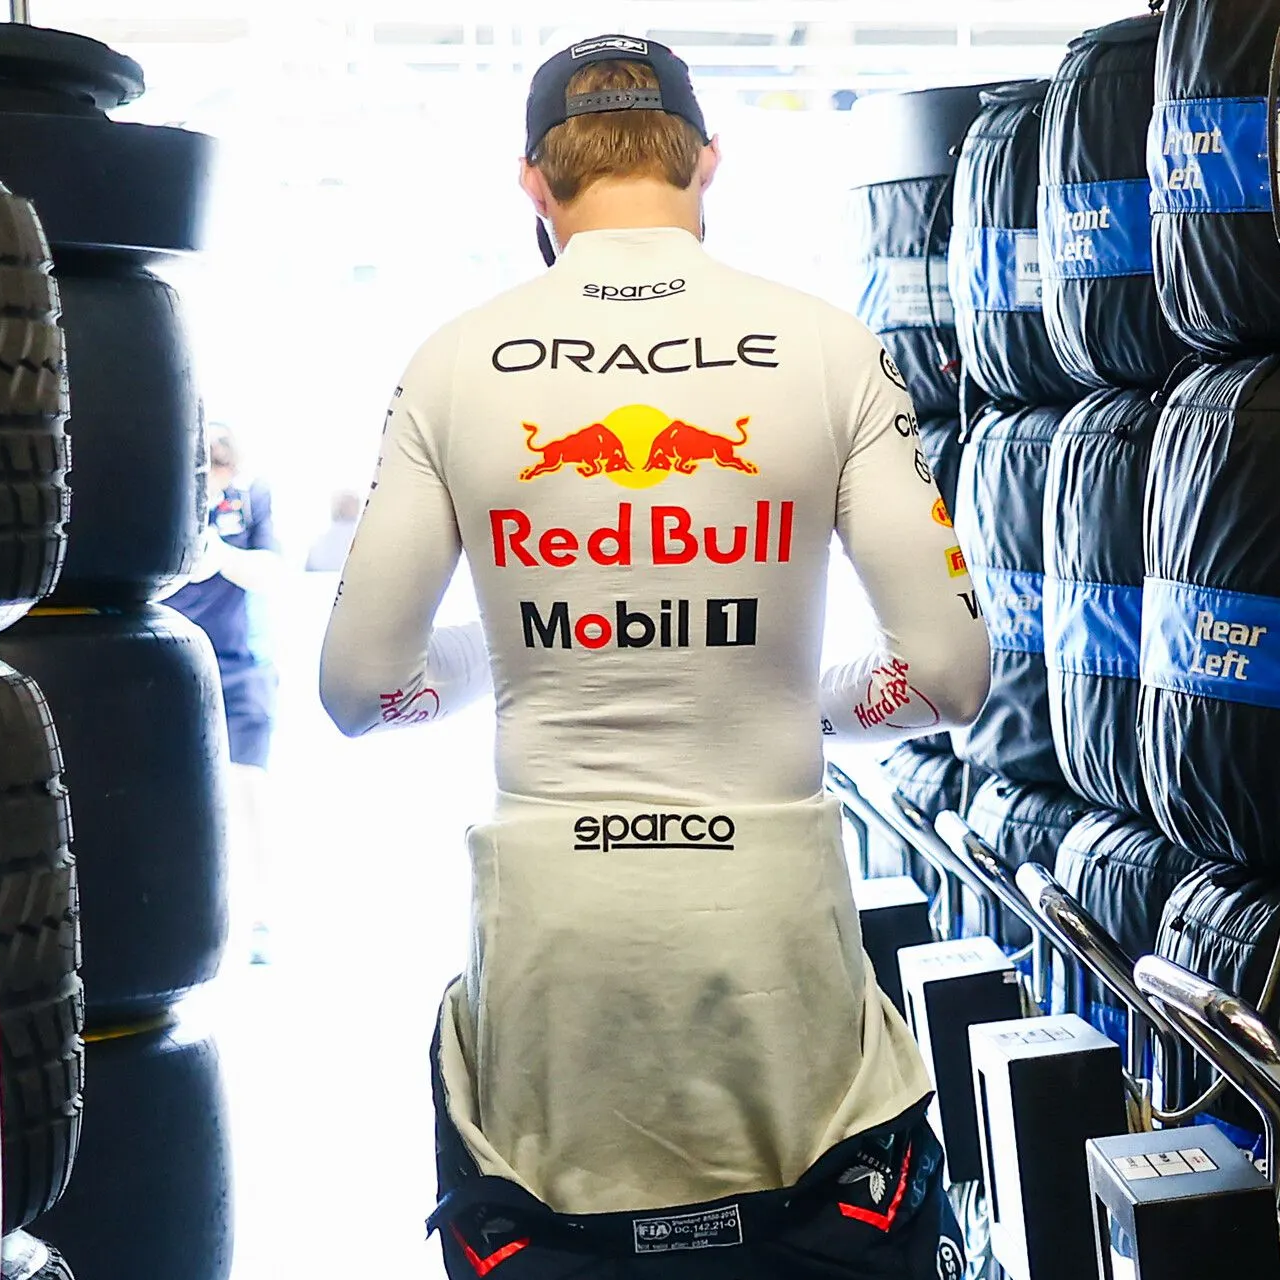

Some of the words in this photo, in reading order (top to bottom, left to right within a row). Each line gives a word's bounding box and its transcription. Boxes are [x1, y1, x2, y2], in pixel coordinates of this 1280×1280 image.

[1166, 162, 1203, 190] eft
[582, 279, 686, 301] sparco
[492, 335, 779, 374] ORACLE
[489, 502, 633, 568] Red
[651, 500, 794, 566] Bull
[520, 600, 689, 650] Mobil
[1194, 610, 1267, 647] Rear
[1190, 648, 1250, 680] Left
[574, 813, 735, 852] sparco
